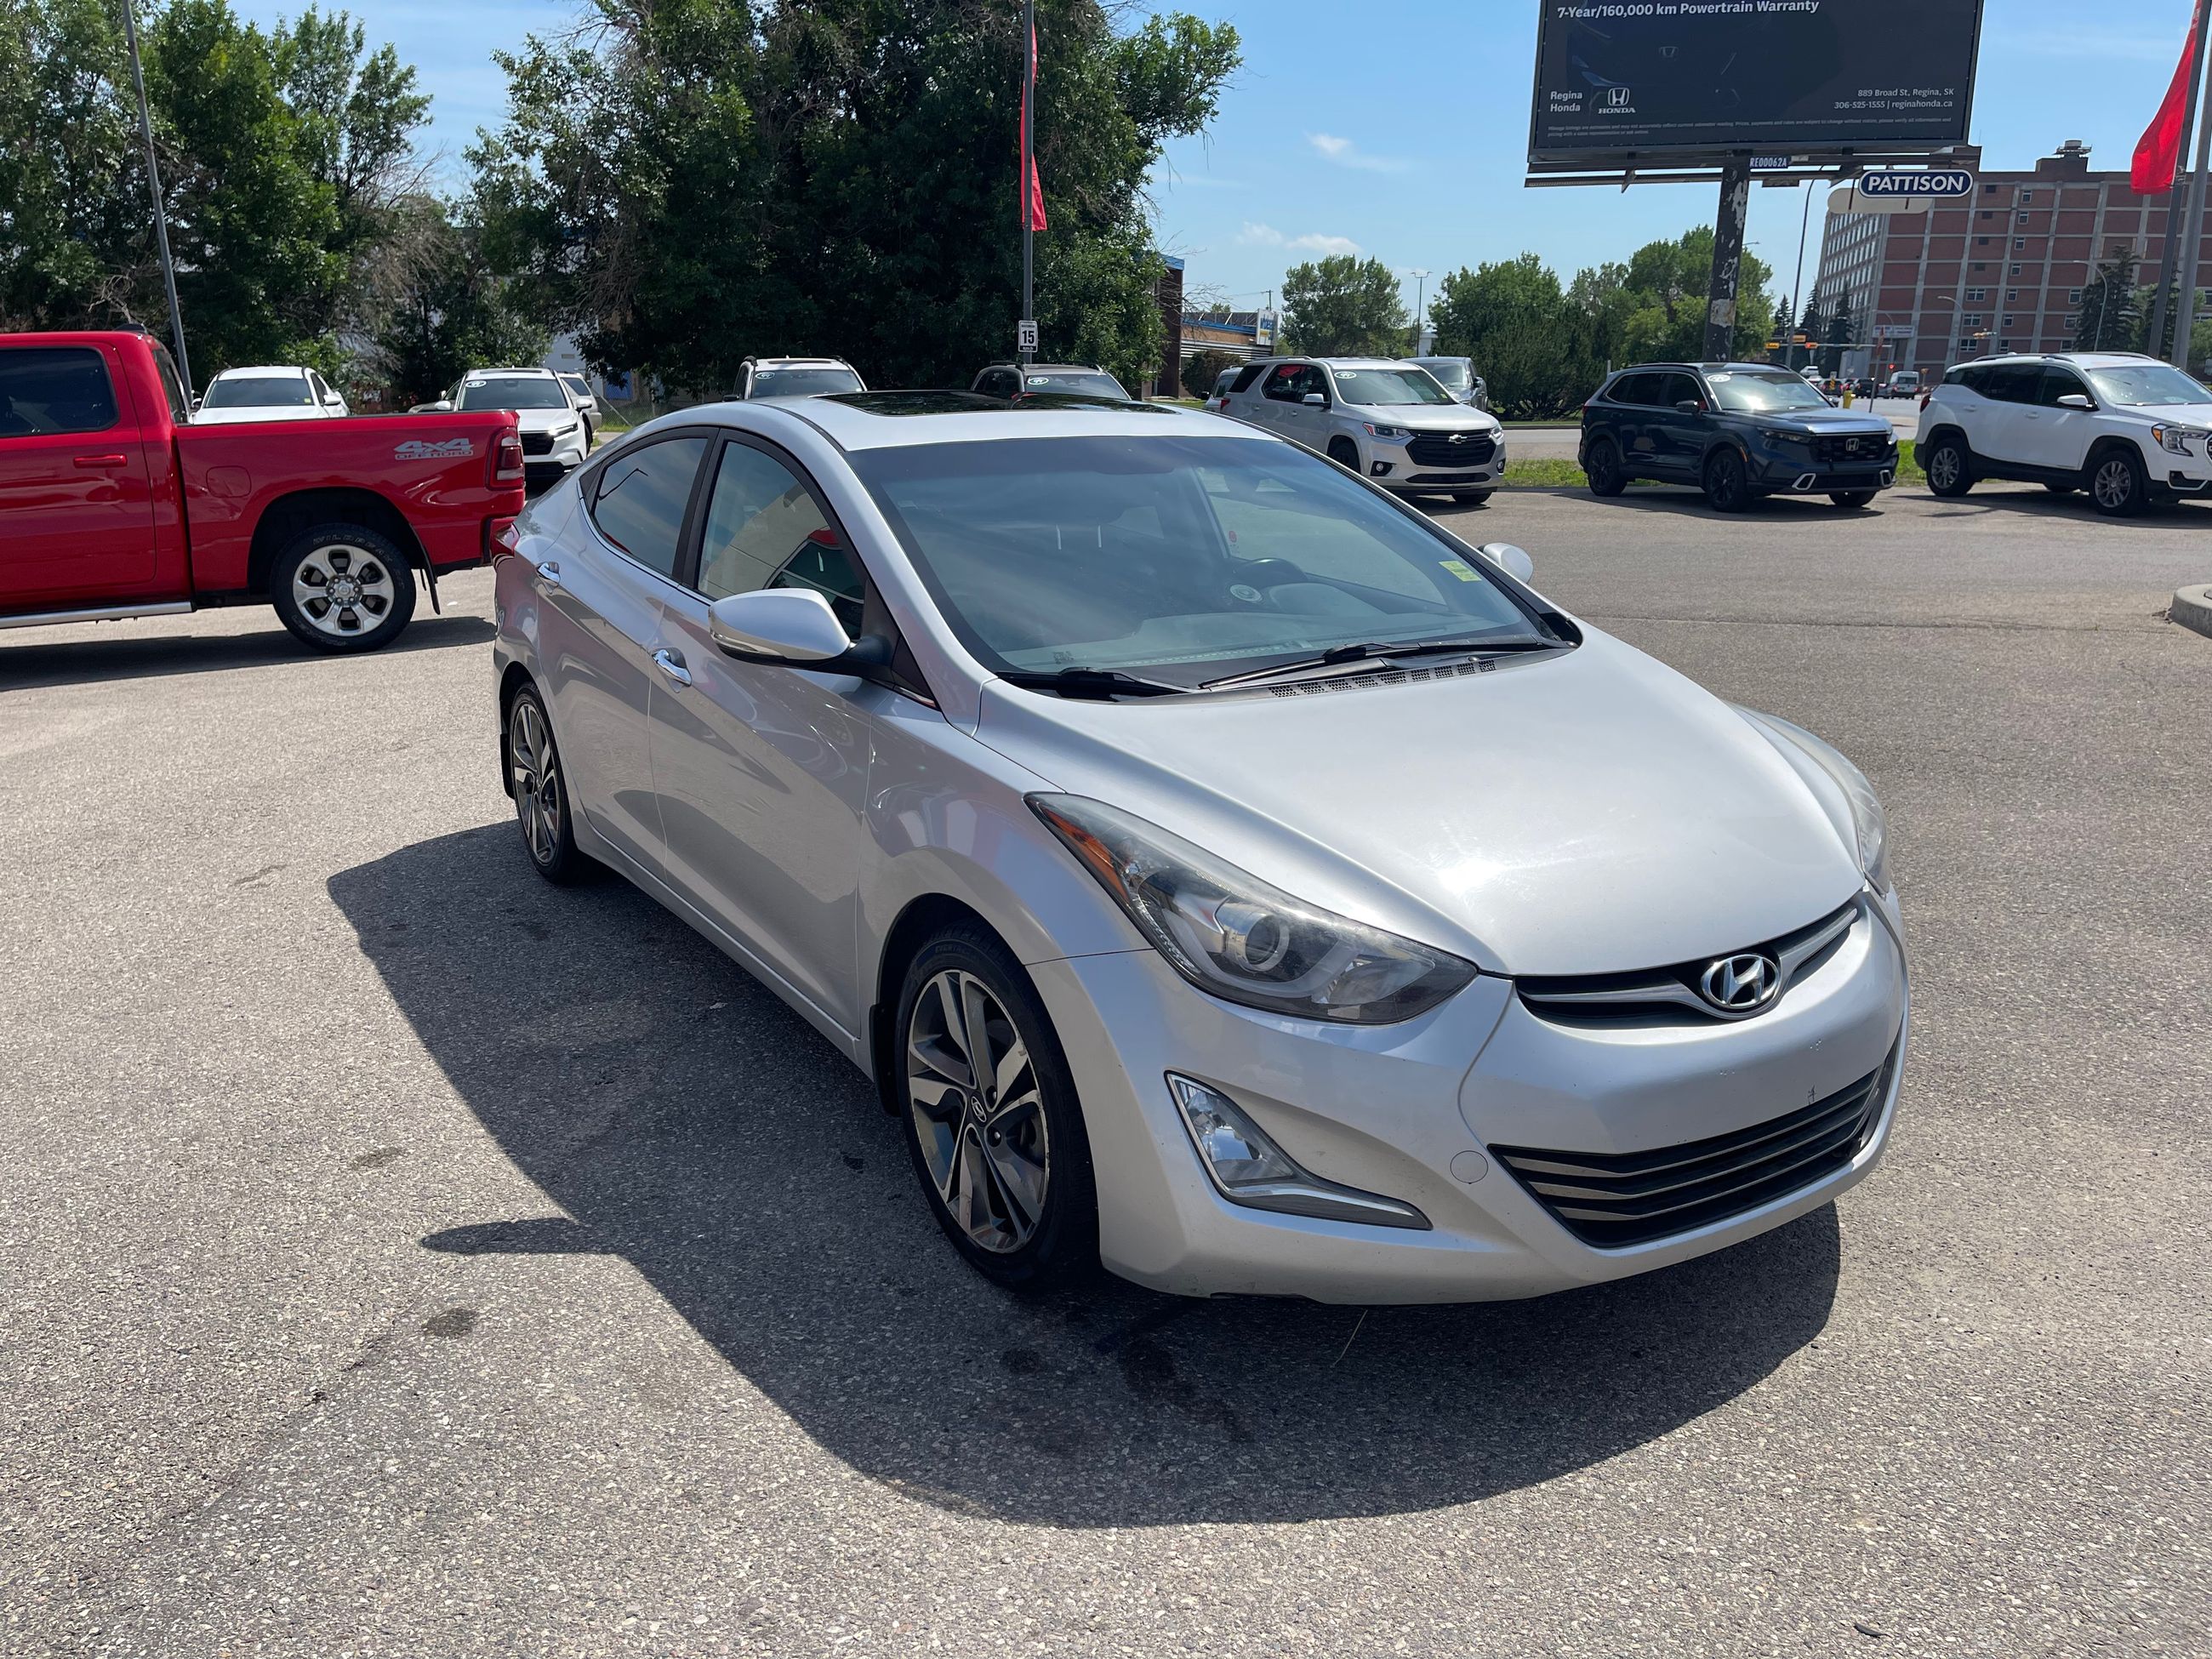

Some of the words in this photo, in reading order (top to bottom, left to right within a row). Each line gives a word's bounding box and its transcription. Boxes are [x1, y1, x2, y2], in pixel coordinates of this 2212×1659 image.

[1558, 4, 1653, 18] 7-Year/160,000
[1656, 3, 1677, 15] km
[1680, 1, 1753, 14] Powertrain
[1756, 0, 1820, 13] Warranty
[1550, 91, 1582, 101] Regina
[1913, 88, 1942, 98] Regina,
[1550, 103, 1581, 111] Honda
[1833, 100, 1885, 109] 306-525-1555
[1891, 100, 1953, 110] reginahonda.ca
[1749, 157, 1787, 168] RE00062A
[1867, 175, 1964, 191] PATTISON
[1022, 330, 1035, 345] 15
[394, 438, 475, 453] 4x4
